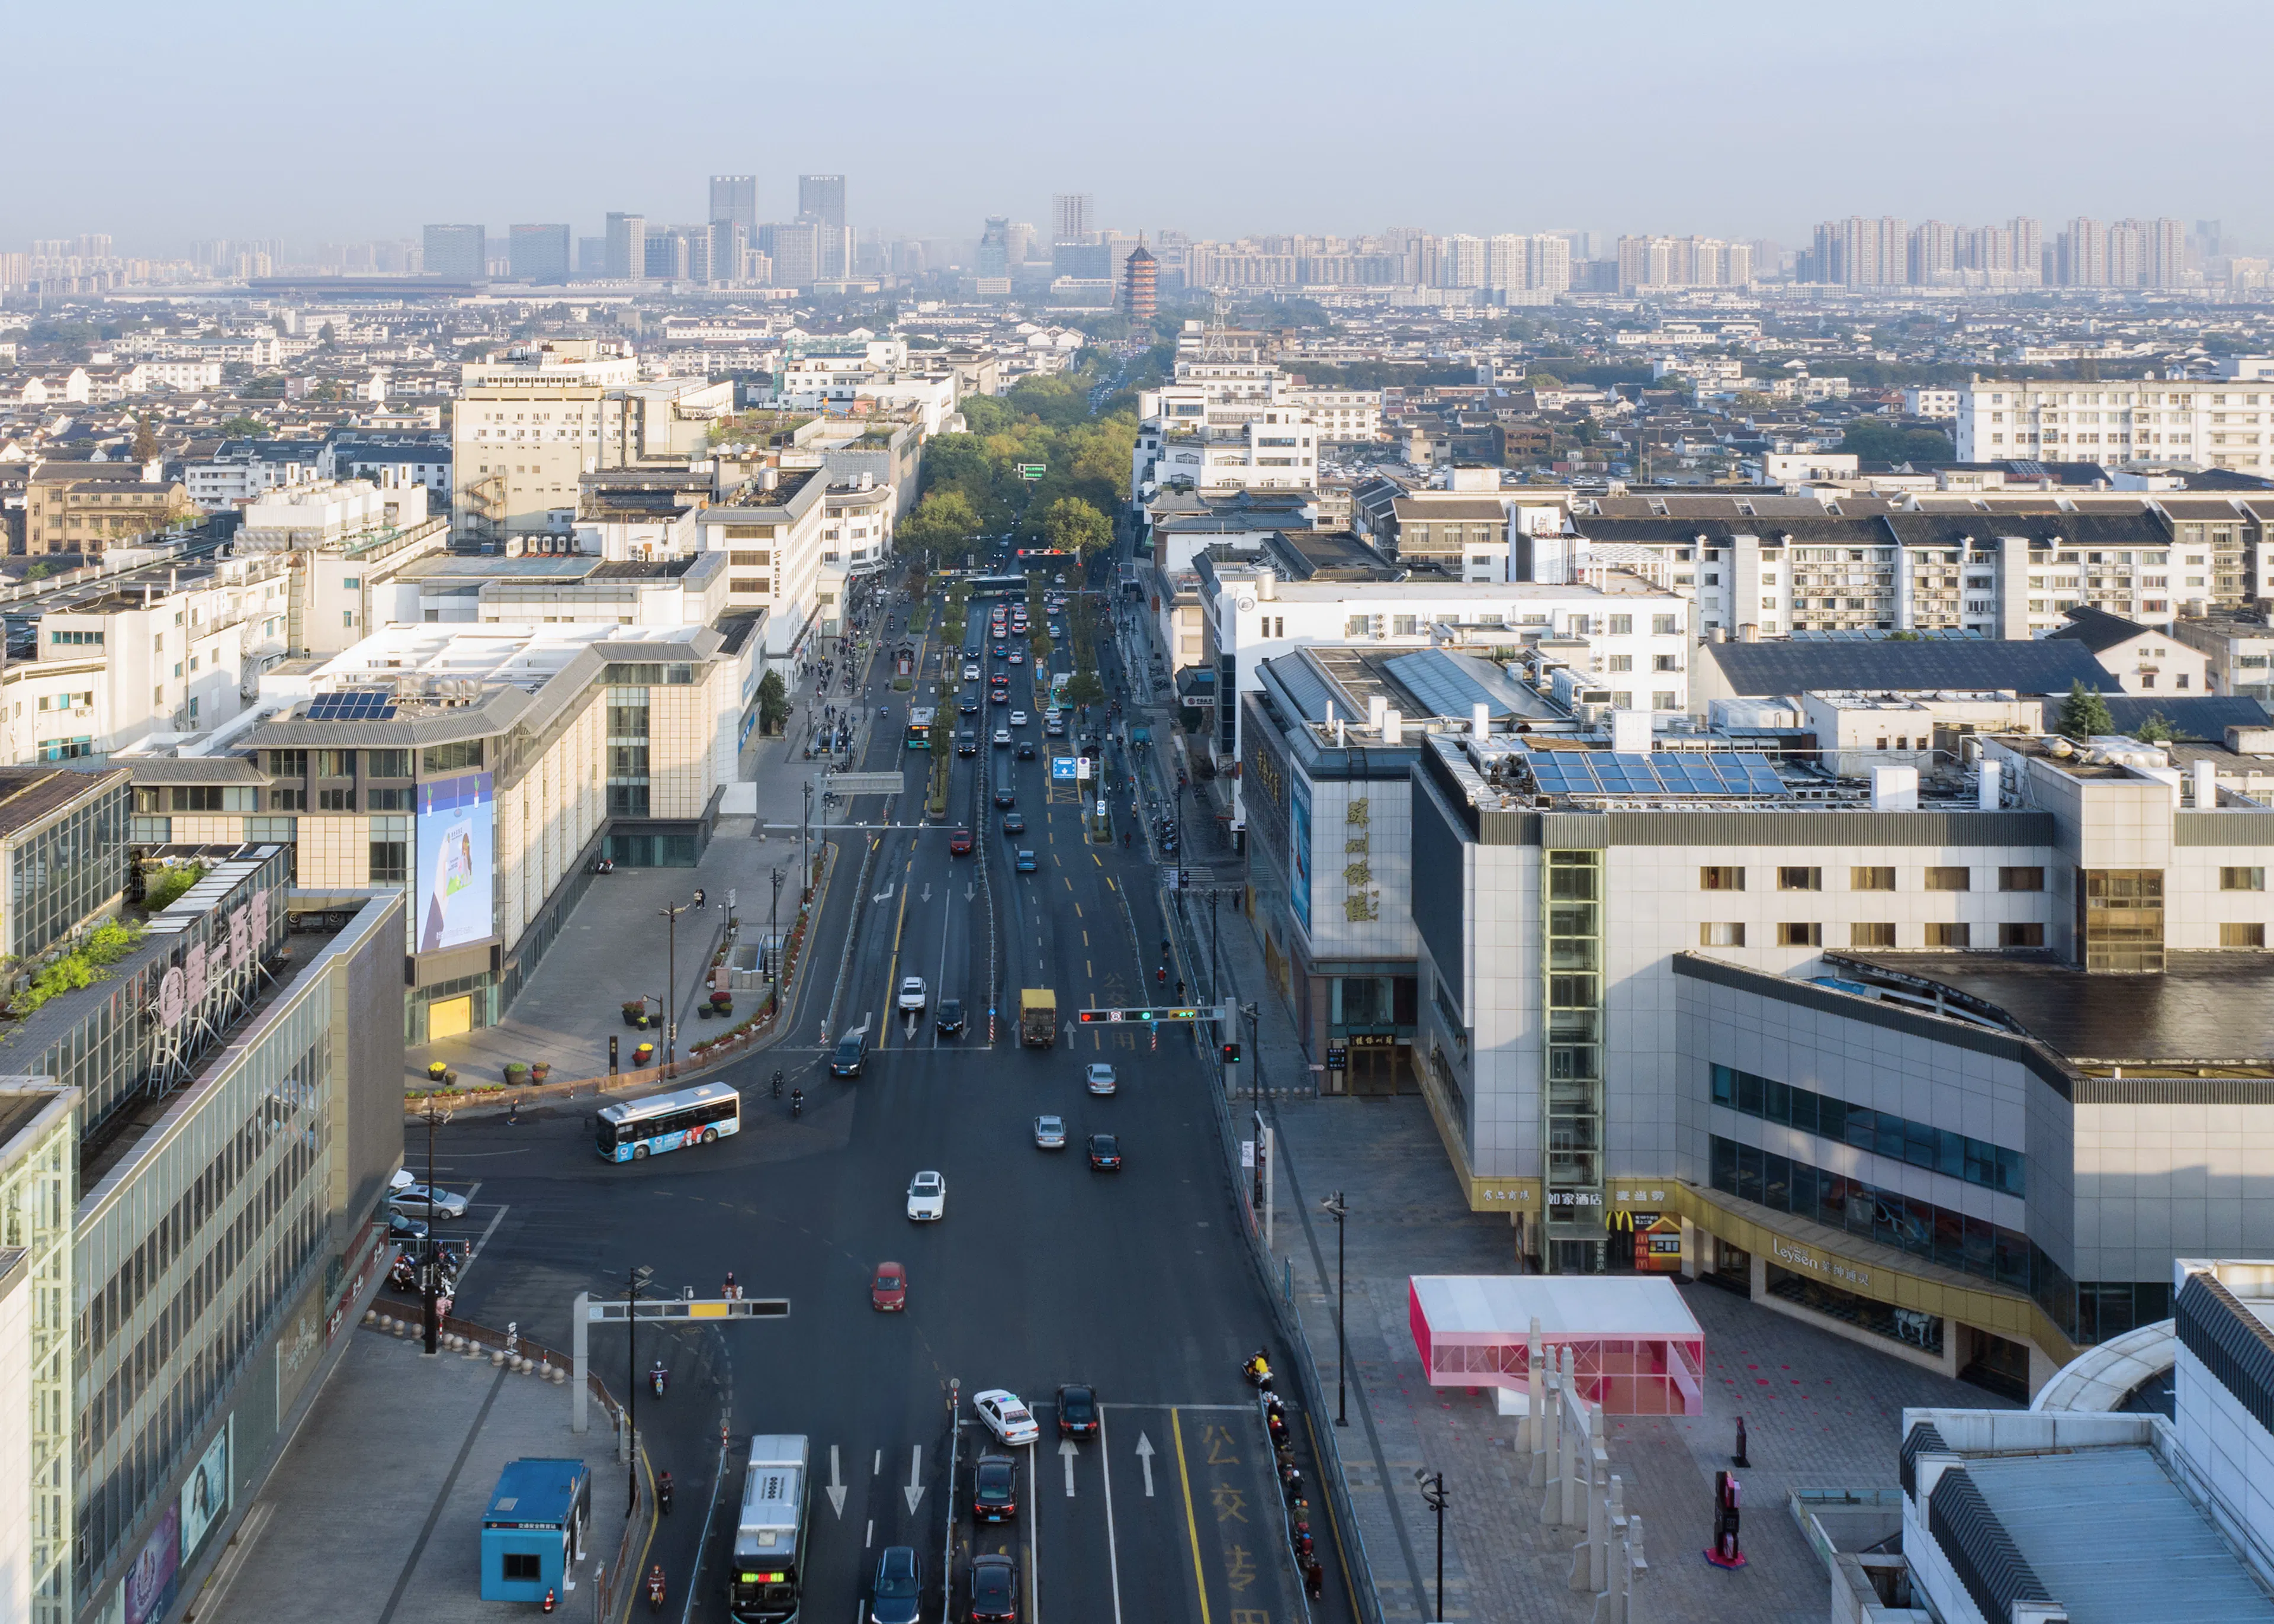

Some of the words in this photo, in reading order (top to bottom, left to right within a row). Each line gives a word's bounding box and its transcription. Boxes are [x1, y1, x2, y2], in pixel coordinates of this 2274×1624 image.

[1548, 1192, 1603, 1206] 如家酒店
[1615, 1190, 1665, 1202] 麦当劳
[1773, 1238, 1818, 1269] Leysen
[1821, 1260, 1869, 1286] 莱绅通灵
